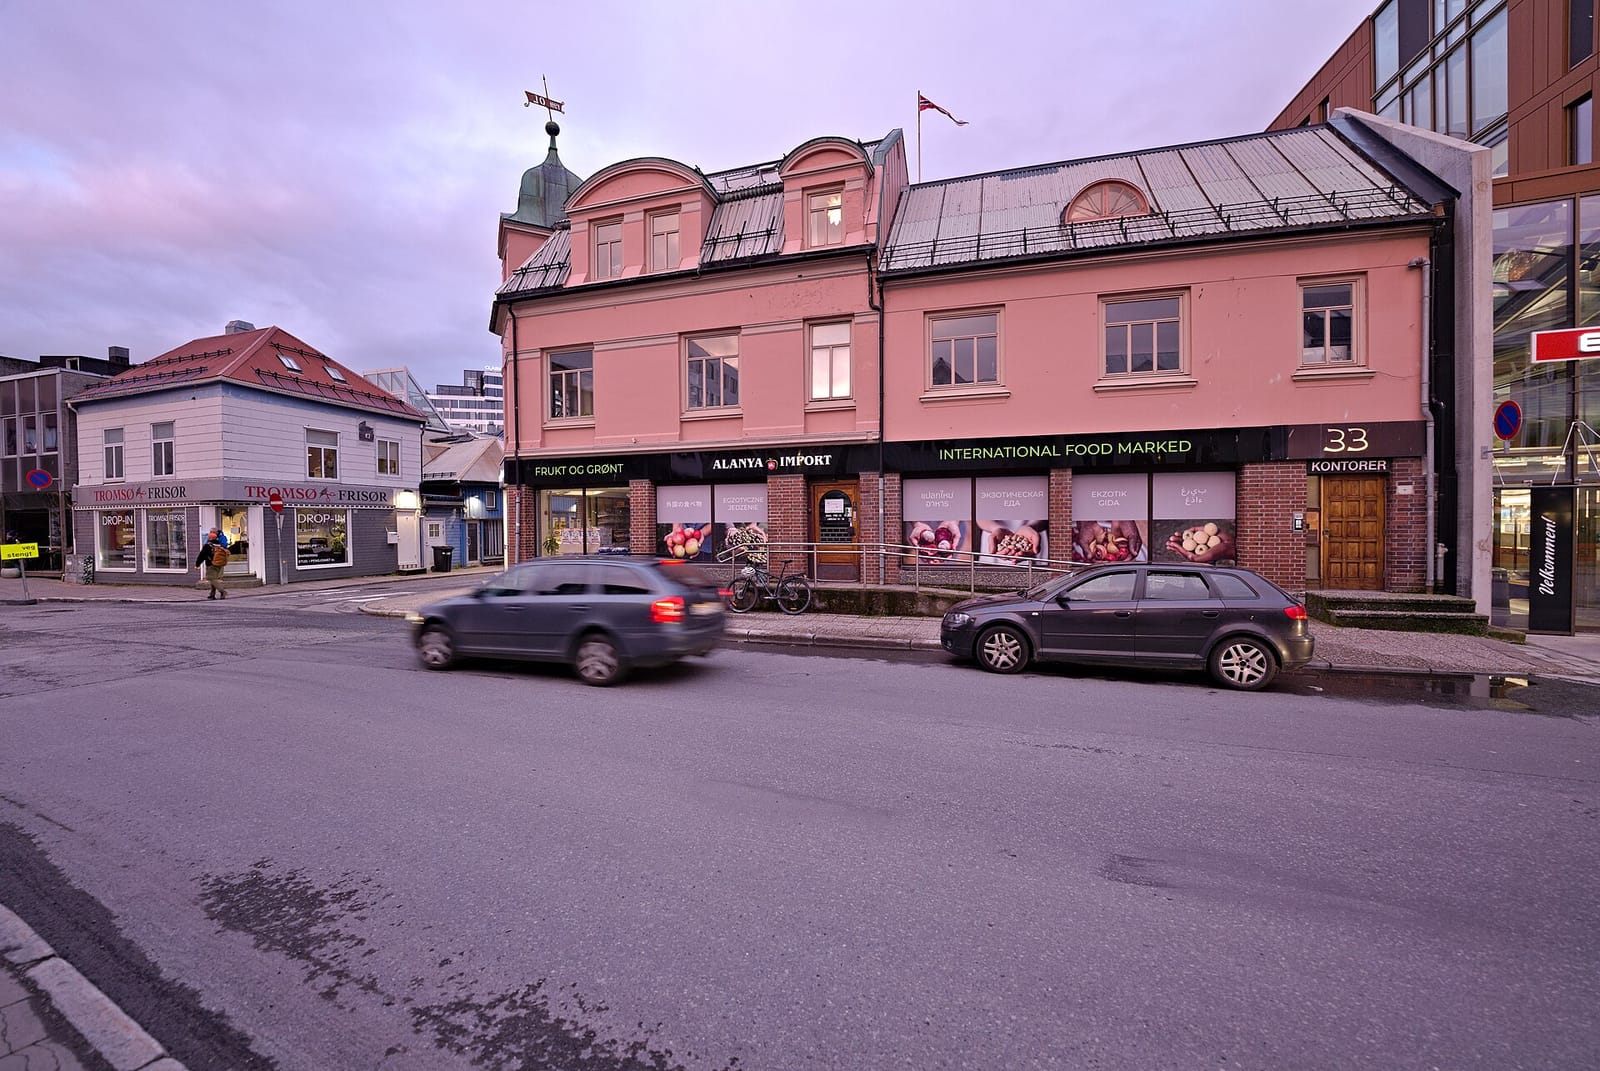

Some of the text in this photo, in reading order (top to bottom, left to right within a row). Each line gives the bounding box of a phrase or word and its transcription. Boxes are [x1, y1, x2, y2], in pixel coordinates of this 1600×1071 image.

[1323, 427, 1369, 453] 33
[938, 440, 1192, 461] INTERNATIONAL FOOD MARKED
[712, 454, 832, 469] ALANYA IMPORT
[1311, 460, 1387, 472] KONTORER
[535, 463, 624, 476] FRUKT OG GRØNT
[94, 485, 187, 502] TROMSØ FRISØR
[244, 485, 388, 502] TROMSØ FRISØR
[981, 490, 1044, 499] ЭКЗОТИЧЕСКАЯ
[1091, 490, 1128, 498] EKZOTIK
[1003, 500, 1021, 508] ЕДА
[1098, 499, 1120, 507] GIDA
[102, 514, 133, 526] DROP-IN
[297, 513, 346, 524] DROP-IN
[1538, 515, 1557, 596] Velkommen!
